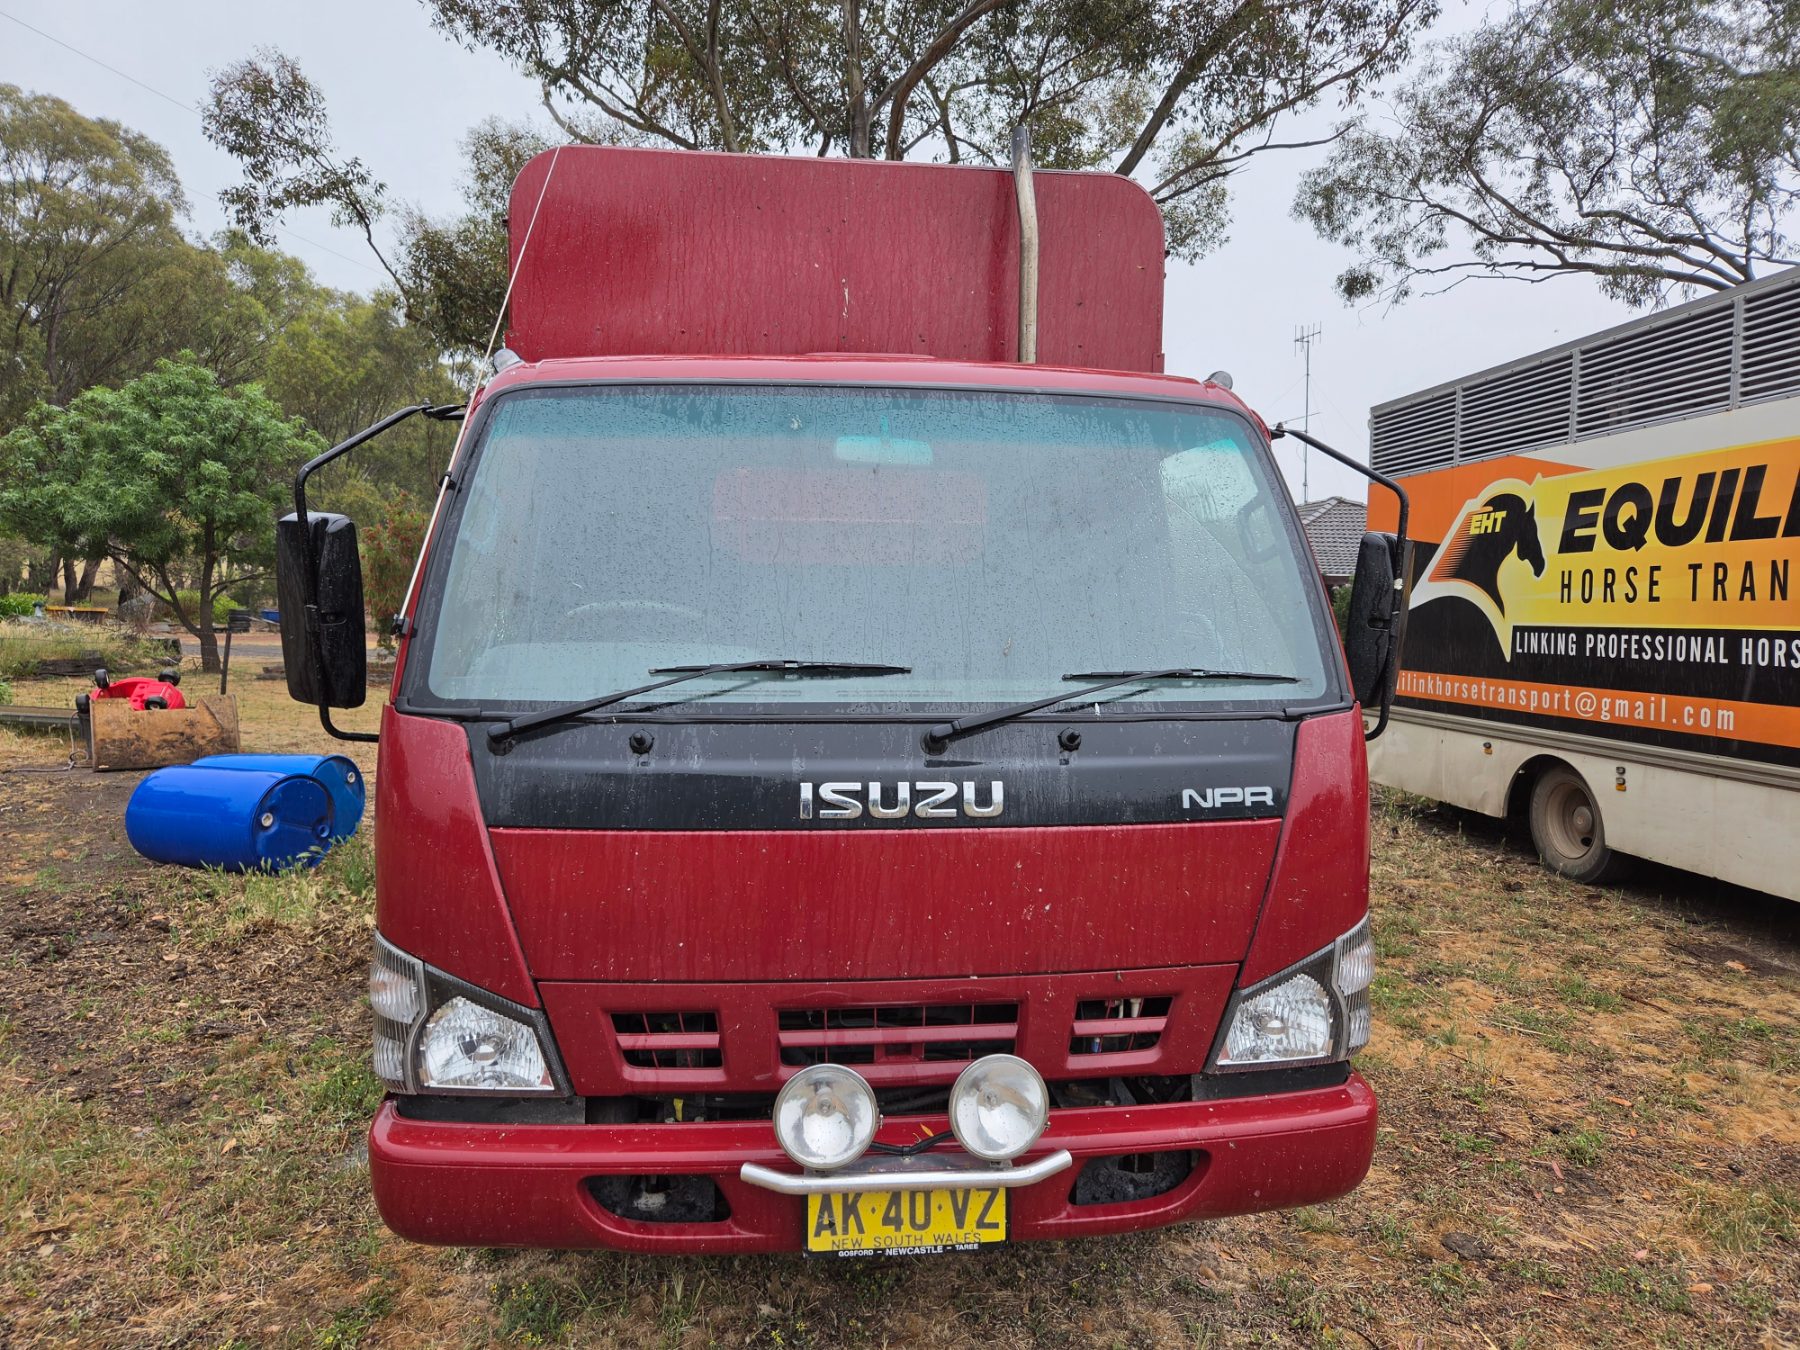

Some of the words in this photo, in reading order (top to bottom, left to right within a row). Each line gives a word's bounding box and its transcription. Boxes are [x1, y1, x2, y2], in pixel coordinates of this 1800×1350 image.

[1470, 511, 1506, 535] EHT
[1560, 564, 1662, 604] HORSE
[1688, 559, 1789, 602] TRAN
[1516, 631, 1577, 656] LINKING
[1586, 633, 1729, 664] PROFESSIONAL
[1741, 637, 1800, 669] HORS
[799, 780, 1003, 819] ISUZU
[1182, 786, 1274, 808] NPR
[813, 1193, 865, 1238] AK
[948, 1187, 1000, 1230] VZ
[831, 1238, 863, 1250] NEW
[873, 1234, 923, 1248] SOUTH
[933, 1231, 981, 1245] WALES
[838, 1249, 874, 1257] GOSFORD
[885, 1245, 944, 1256] NEWCASTLE
[955, 1243, 979, 1251] TAREE
